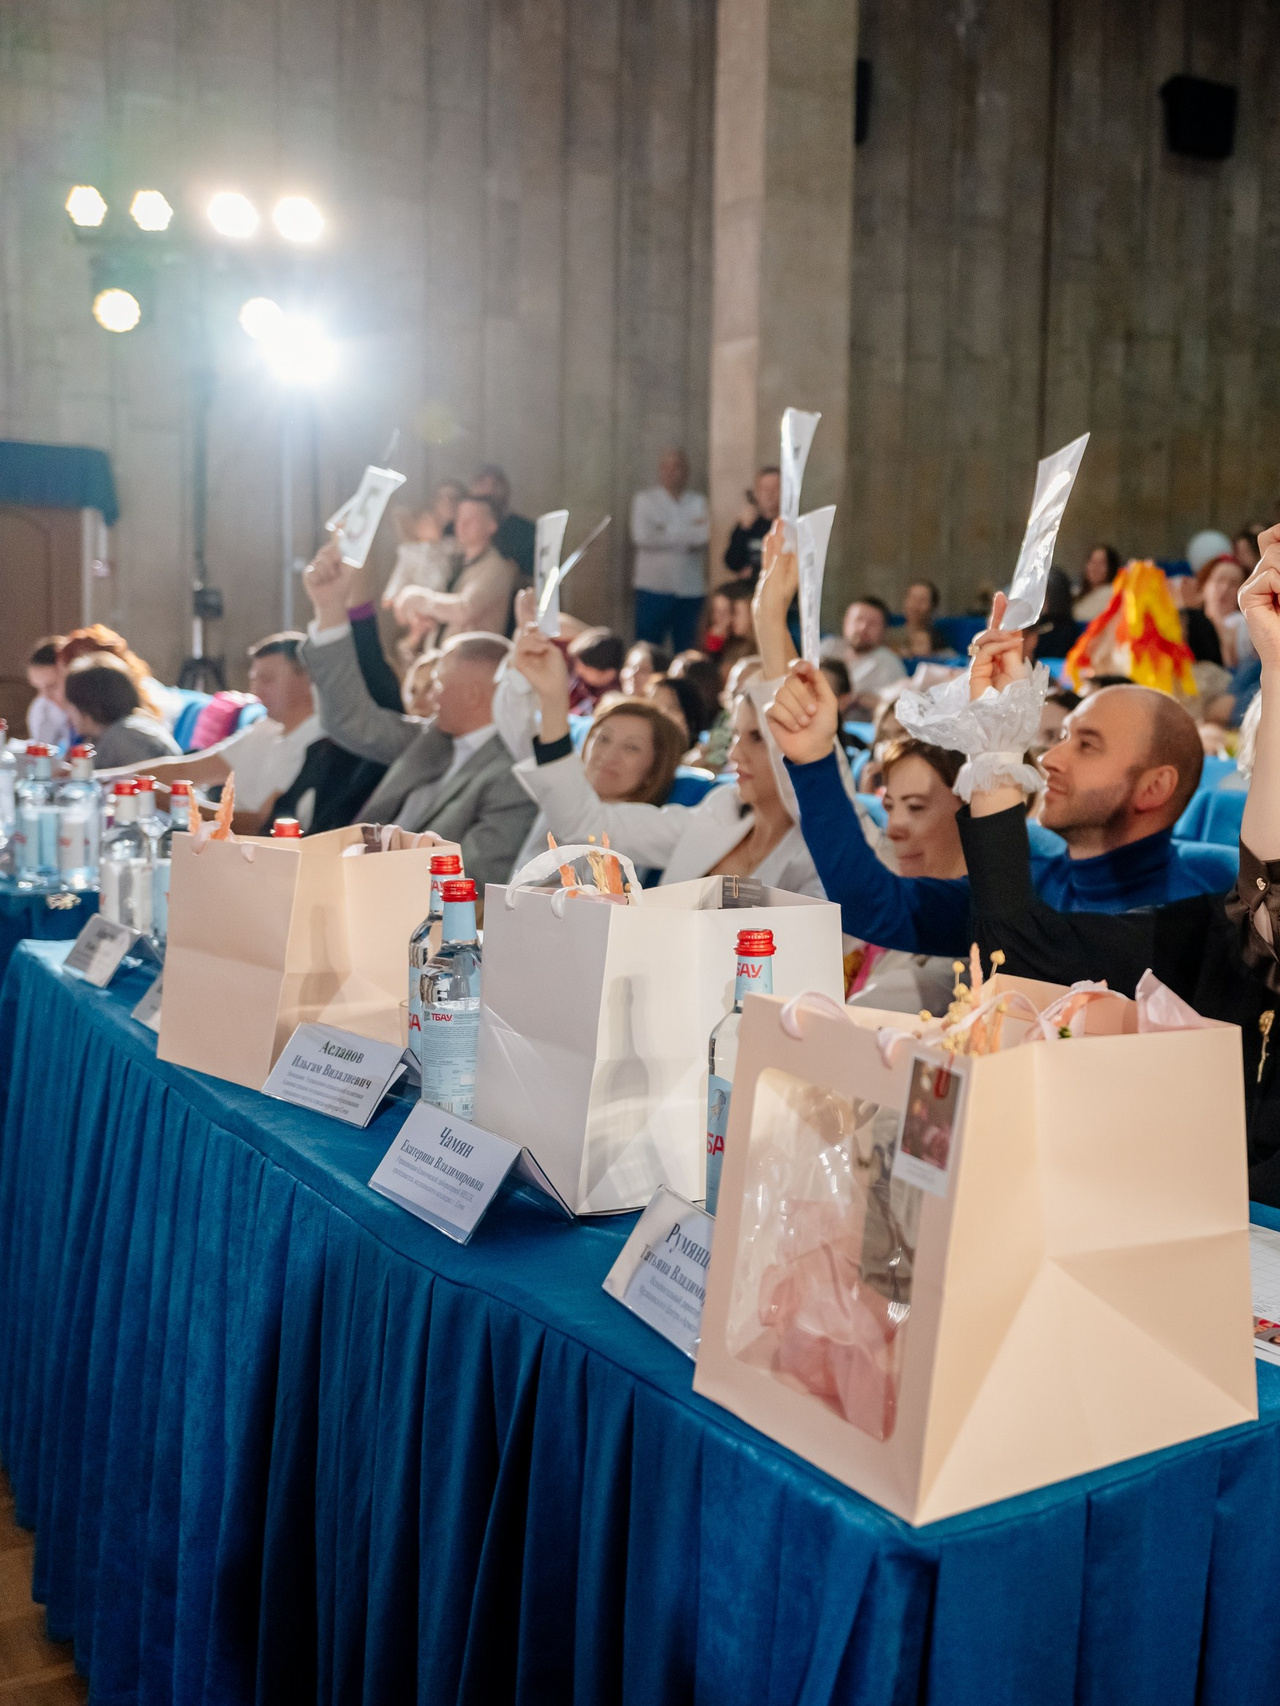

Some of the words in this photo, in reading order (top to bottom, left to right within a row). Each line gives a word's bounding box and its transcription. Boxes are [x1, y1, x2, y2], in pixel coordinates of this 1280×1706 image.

[431, 1012, 453, 1021] ТБАУ
[291, 1054, 323, 1074] Ильгам
[319, 1040, 365, 1064] Асланов
[439, 1126, 475, 1159] Чамян
[400, 1139, 435, 1166] Екатерина
[433, 1156, 486, 1192] Владимировна
[640, 1243, 671, 1276] Татьяна
[665, 1222, 711, 1271] Румянц
